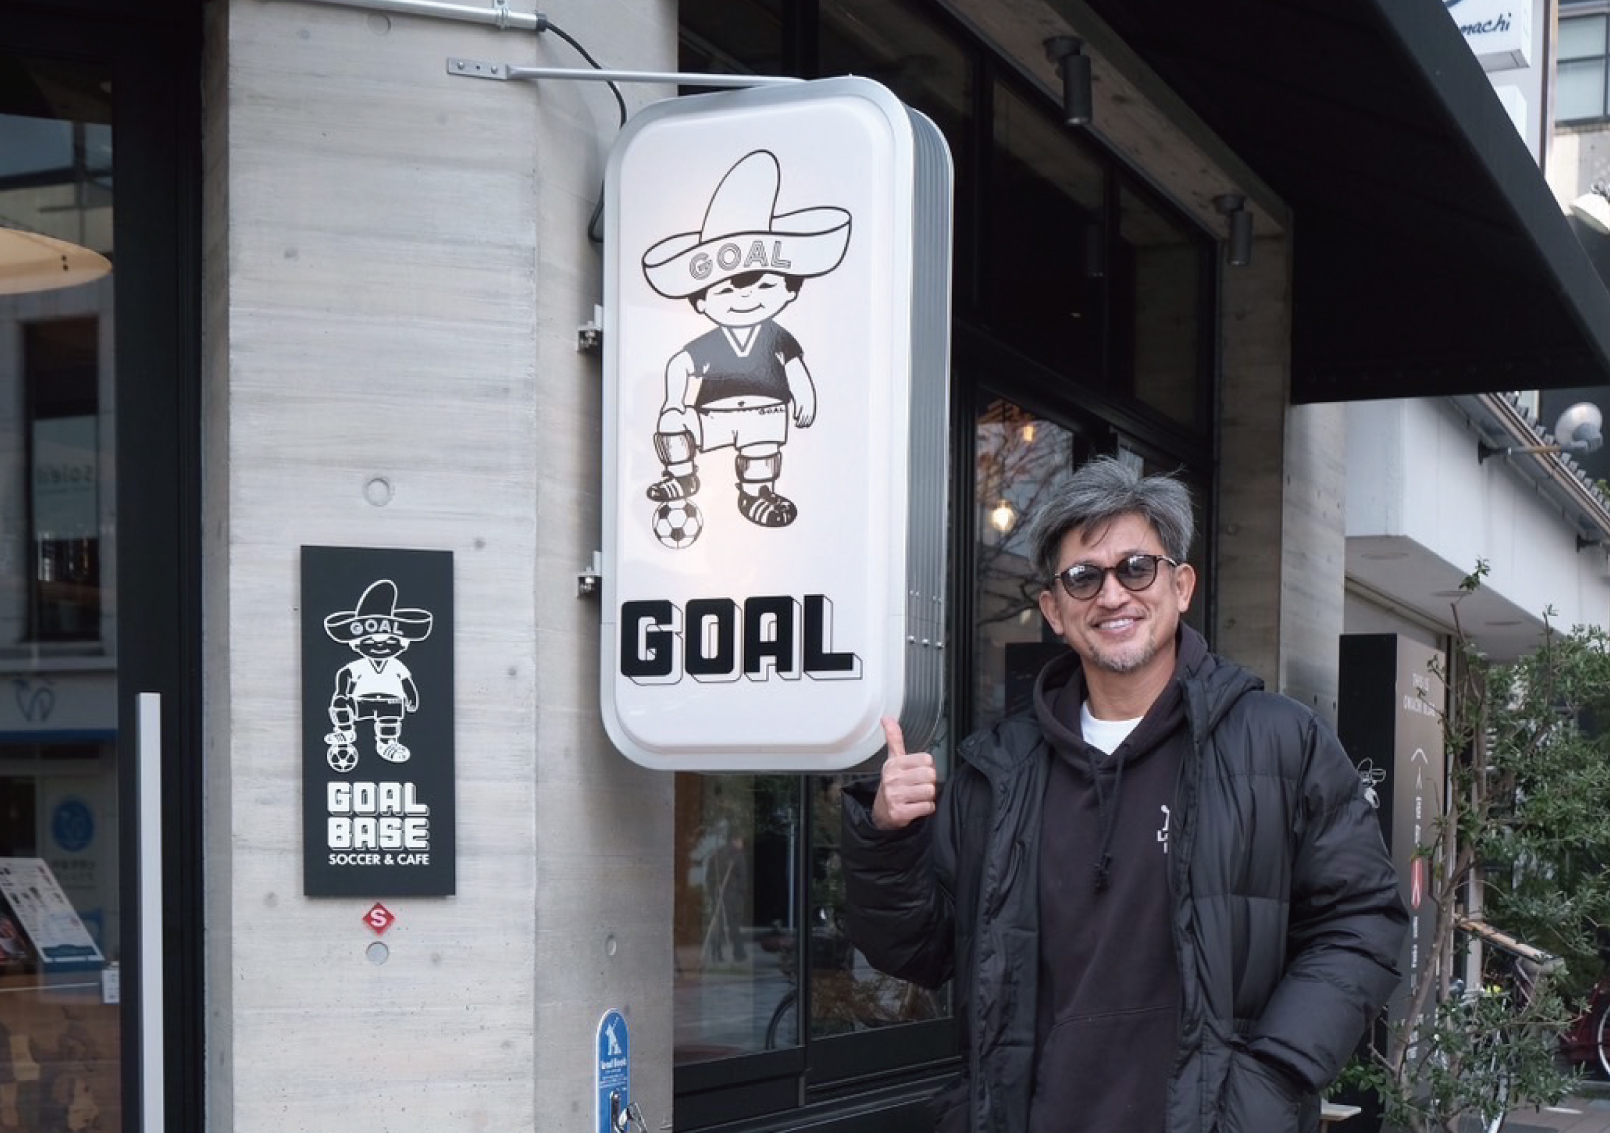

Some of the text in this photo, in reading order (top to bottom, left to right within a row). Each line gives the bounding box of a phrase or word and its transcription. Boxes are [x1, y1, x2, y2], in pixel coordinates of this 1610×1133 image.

[689, 240, 791, 280] GOAL
[350, 619, 404, 636] GOAL
[621, 594, 863, 686] GOAL
[327, 782, 430, 816] GOAL
[327, 817, 430, 850] BASE
[328, 854, 429, 866] SOCCER & CAFE
[370, 908, 387, 928] S
